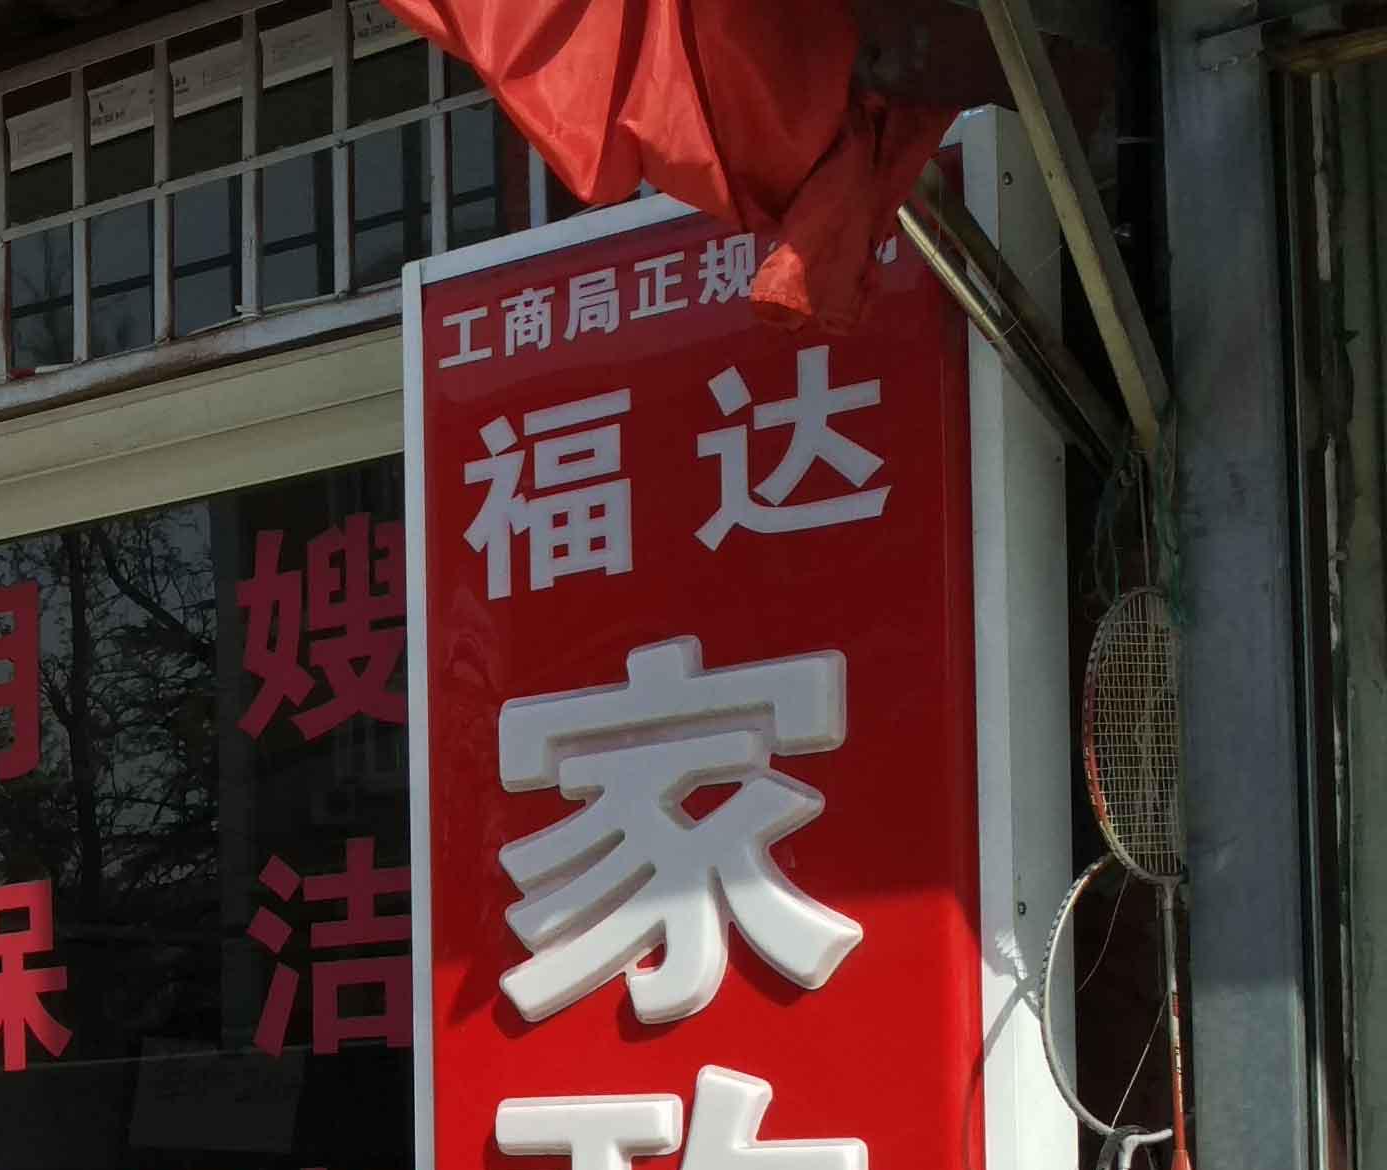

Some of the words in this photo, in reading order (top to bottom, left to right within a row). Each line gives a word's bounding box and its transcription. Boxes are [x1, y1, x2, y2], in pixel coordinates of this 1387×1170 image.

[438, 233, 898, 369] 工商局正规
[463, 344, 892, 601] 福达
